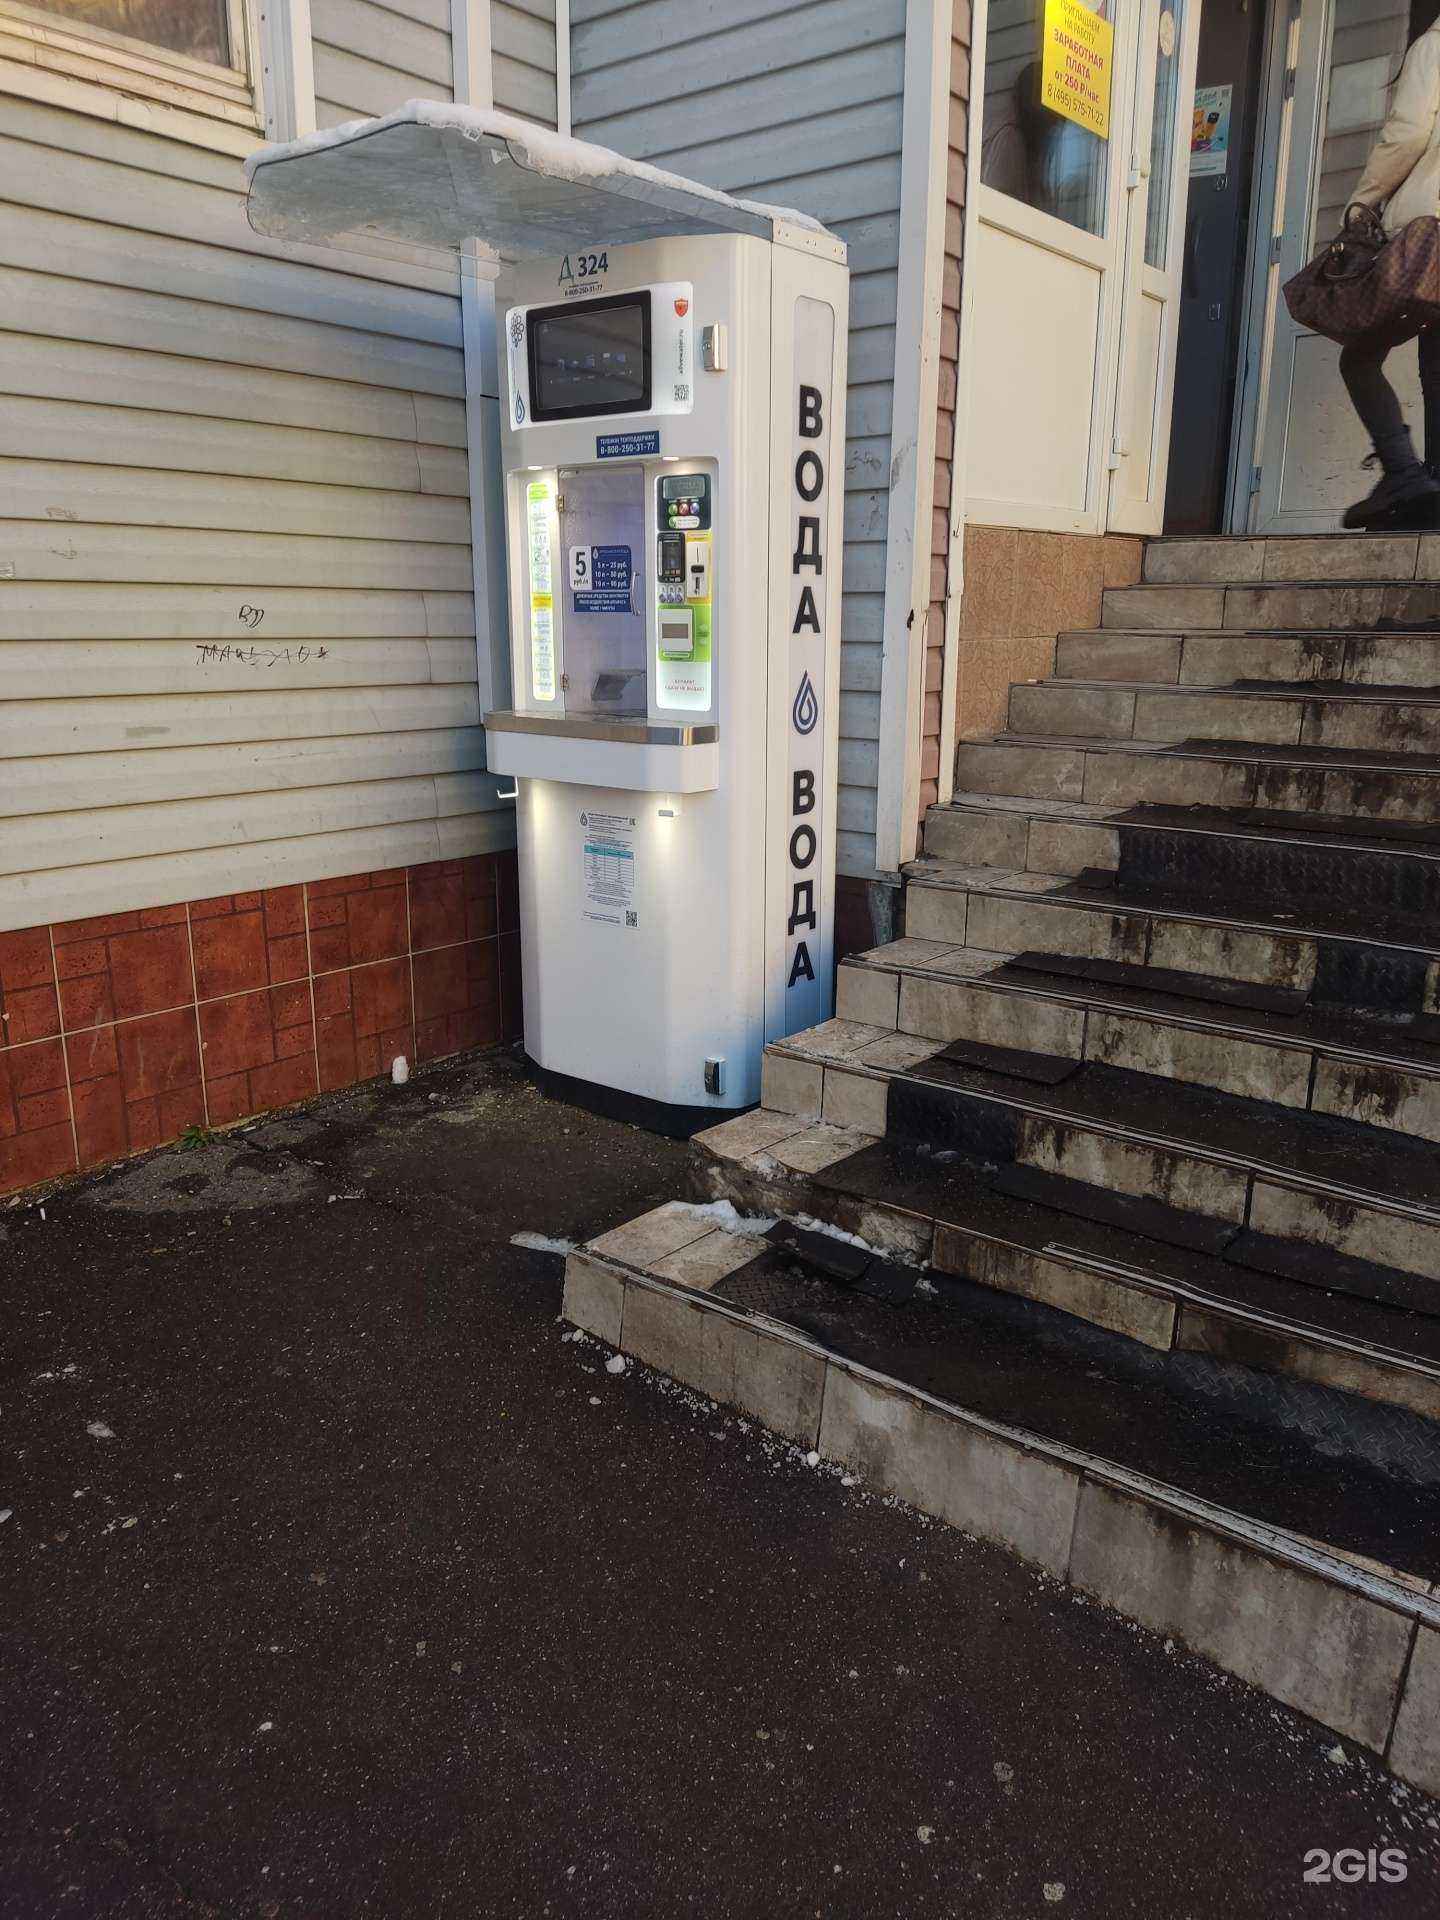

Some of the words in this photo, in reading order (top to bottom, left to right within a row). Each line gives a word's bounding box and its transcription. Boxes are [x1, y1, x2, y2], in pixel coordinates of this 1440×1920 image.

[1054, 28, 1104, 70] ЗАРАБОТНАЯ
[1054, 70, 1063, 82] от
[1064, 73, 1079, 91] 250
[1065, 54, 1091, 80] ПЛАТА
[1047, 83, 1053, 97] 8
[1053, 87, 1072, 111] (495)
[578, 251, 609, 277] 324
[792, 385, 824, 634] ВОДА
[575, 551, 587, 576] 5
[787, 769, 817, 988] ВОДА
